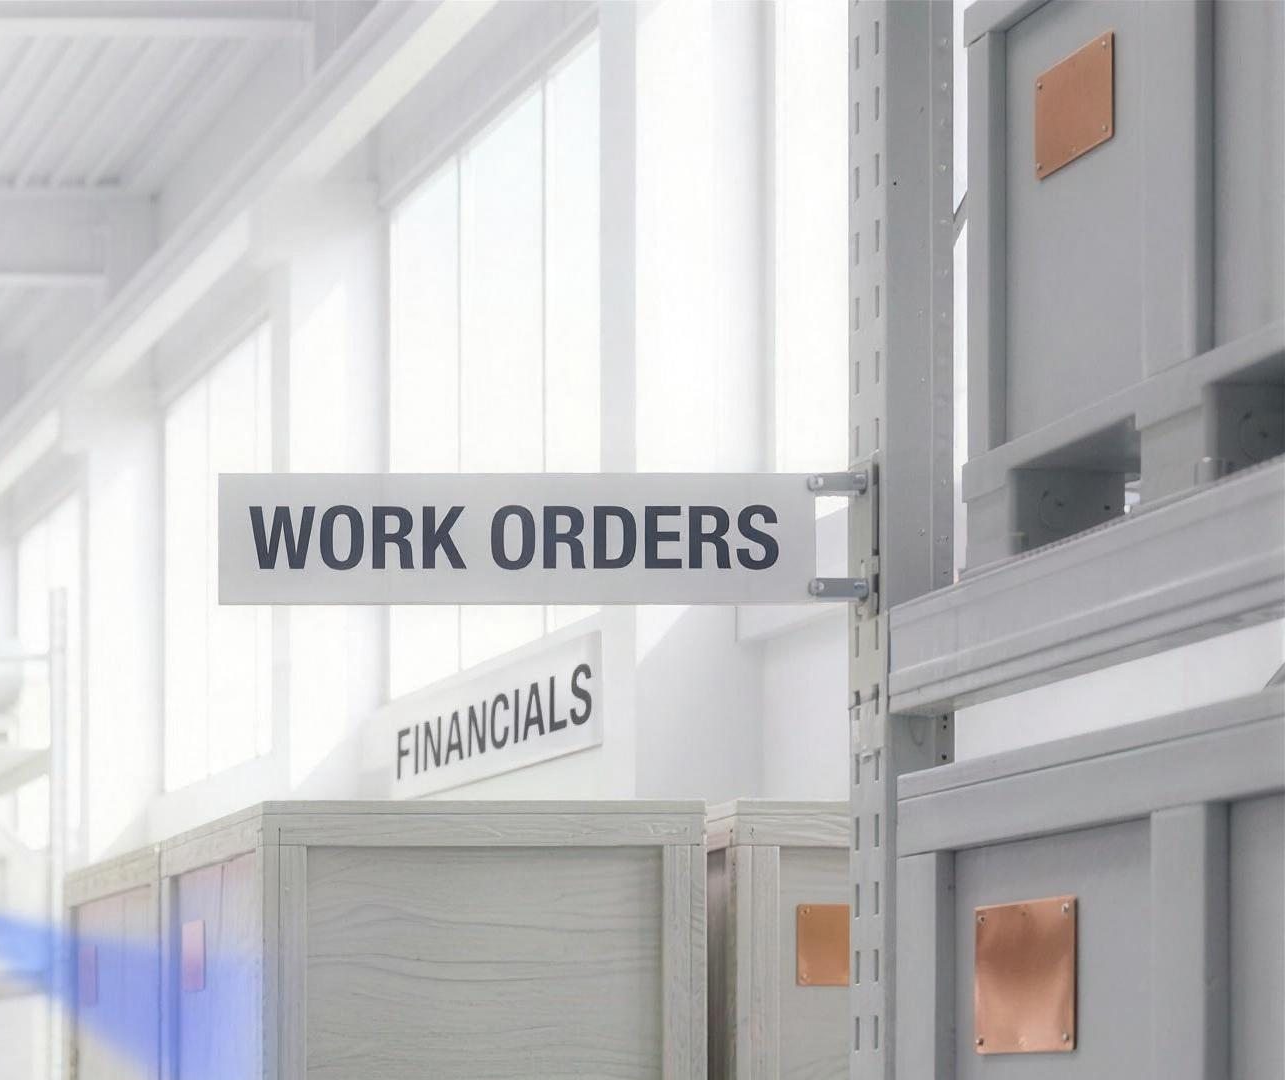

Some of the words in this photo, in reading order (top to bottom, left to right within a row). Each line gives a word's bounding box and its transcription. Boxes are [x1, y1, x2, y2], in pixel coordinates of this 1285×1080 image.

[248, 504, 468, 571] WORK
[490, 504, 780, 571] ORDERS
[396, 663, 593, 781] FINANCIALS
